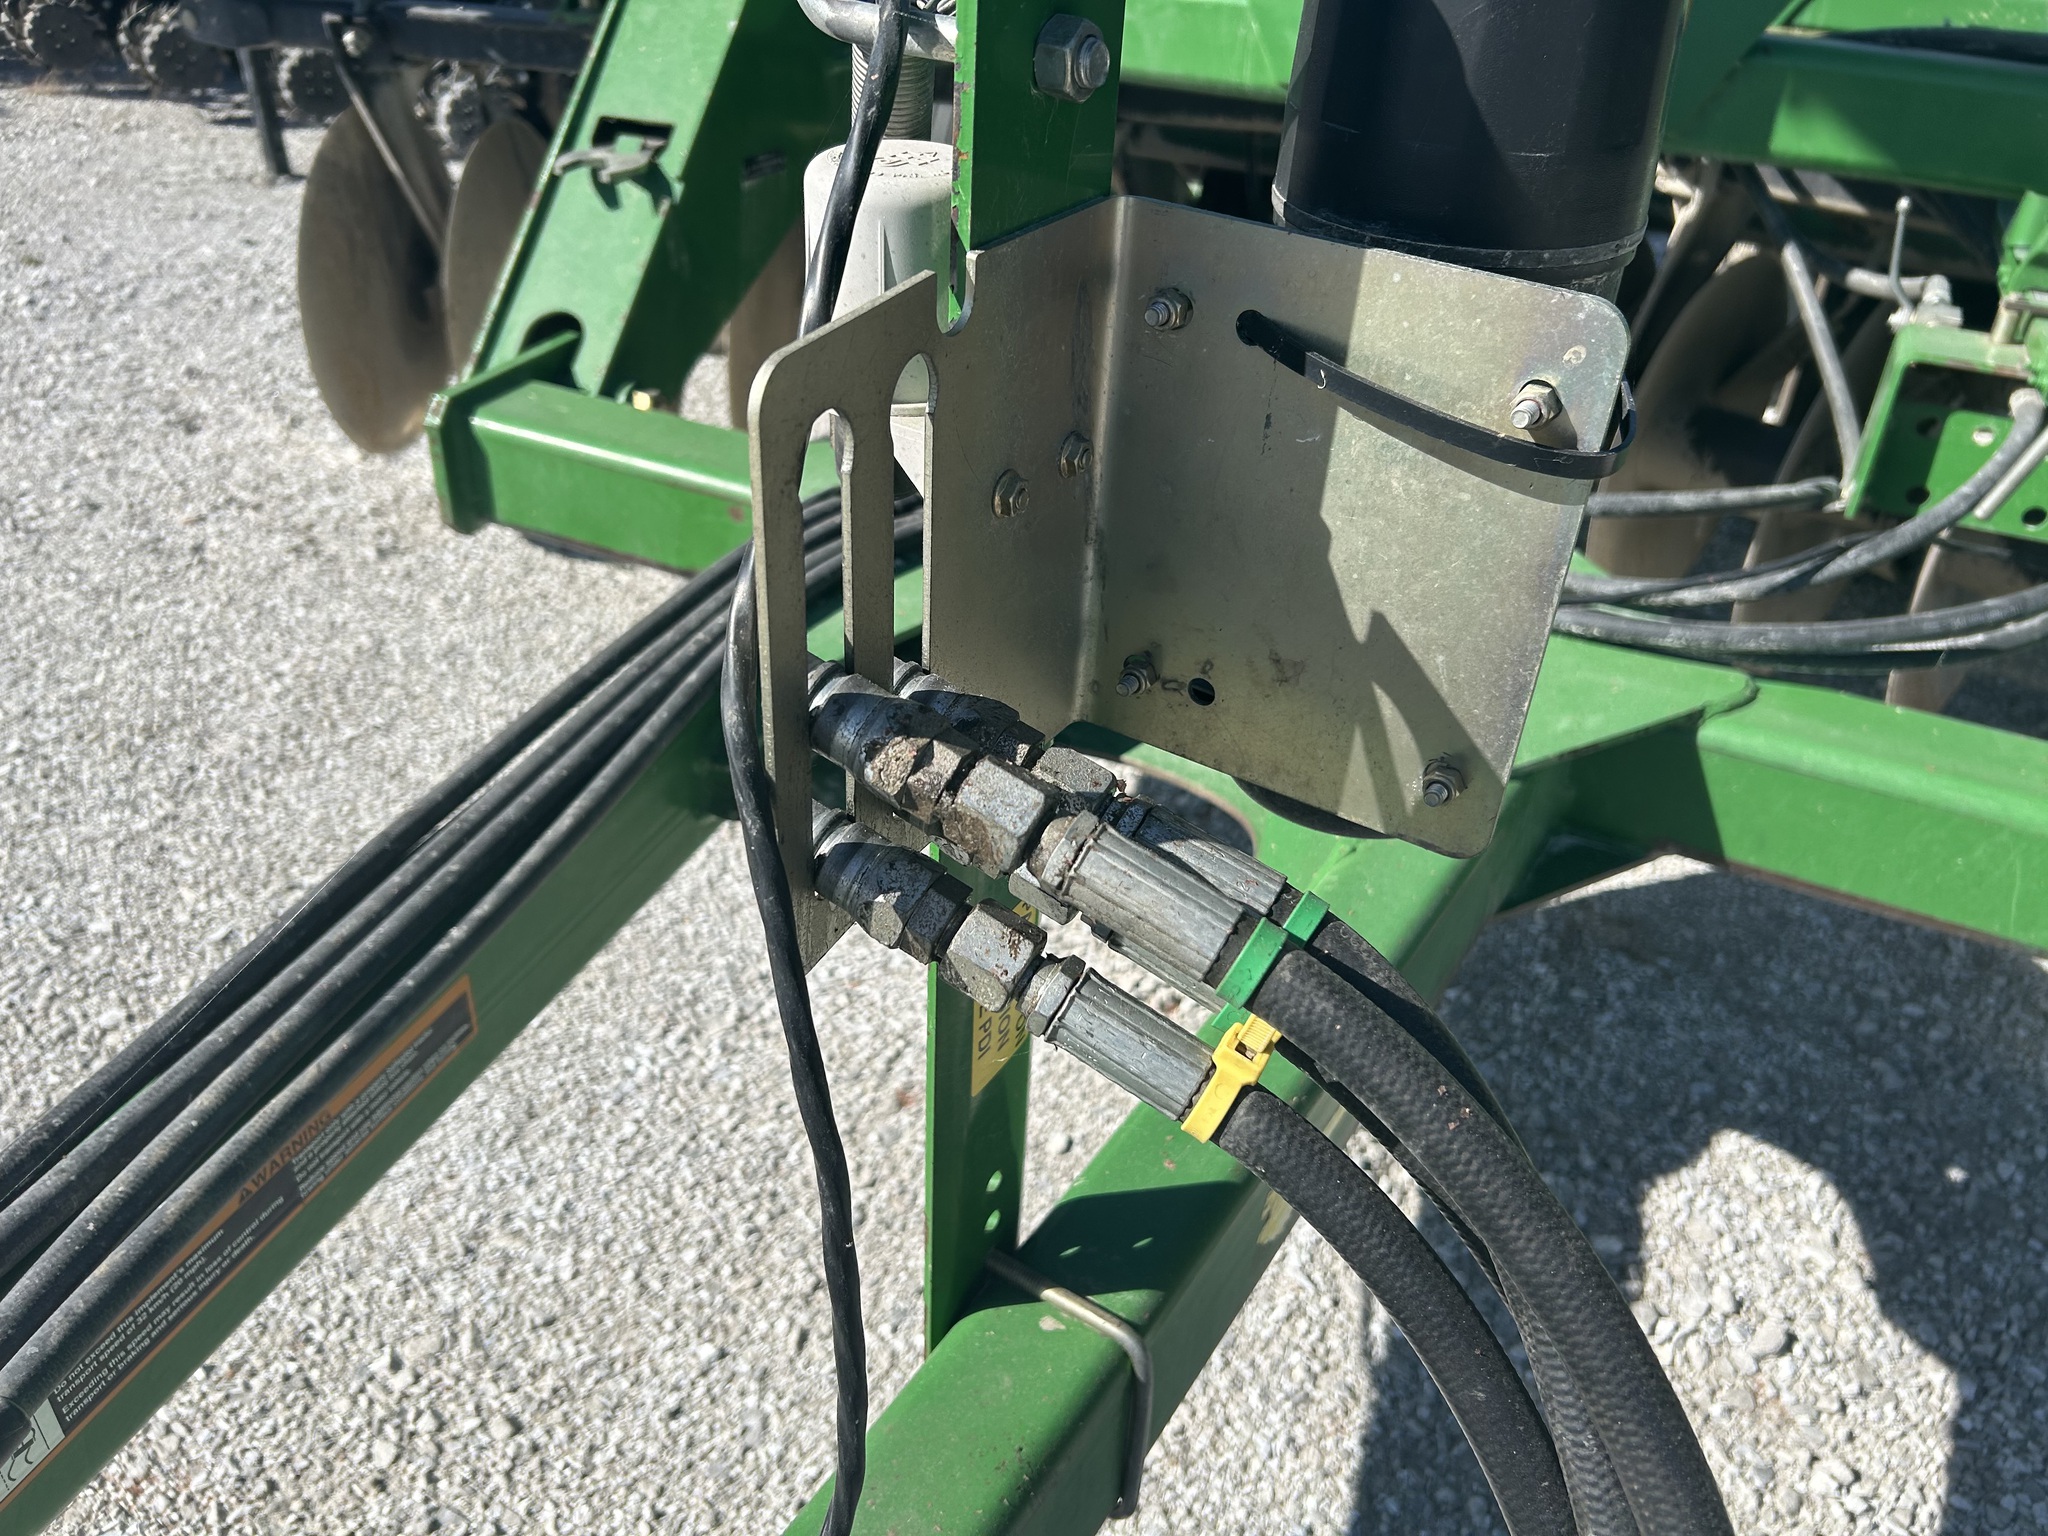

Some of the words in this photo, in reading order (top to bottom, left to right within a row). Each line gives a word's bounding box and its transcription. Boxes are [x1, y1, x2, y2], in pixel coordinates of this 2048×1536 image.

[252, 1108, 331, 1188] WARNING
[54, 1380, 67, 1394] Do
[68, 1363, 83, 1380] not
[84, 1331, 116, 1364] exceed
[117, 1315, 133, 1332] this
[57, 1360, 99, 1403] transport
[98, 1333, 126, 1363] speed
[126, 1323, 136, 1335] of
[62, 1367, 109, 1414] Exceeding
[109, 1350, 125, 1367] this
[126, 1323, 153, 1351] speed
[153, 1305, 172, 1325] may
[66, 1380, 107, 1422] transport
[107, 1369, 117, 1381] or
[118, 1337, 150, 1370] braking
[150, 1319, 167, 1338] and
